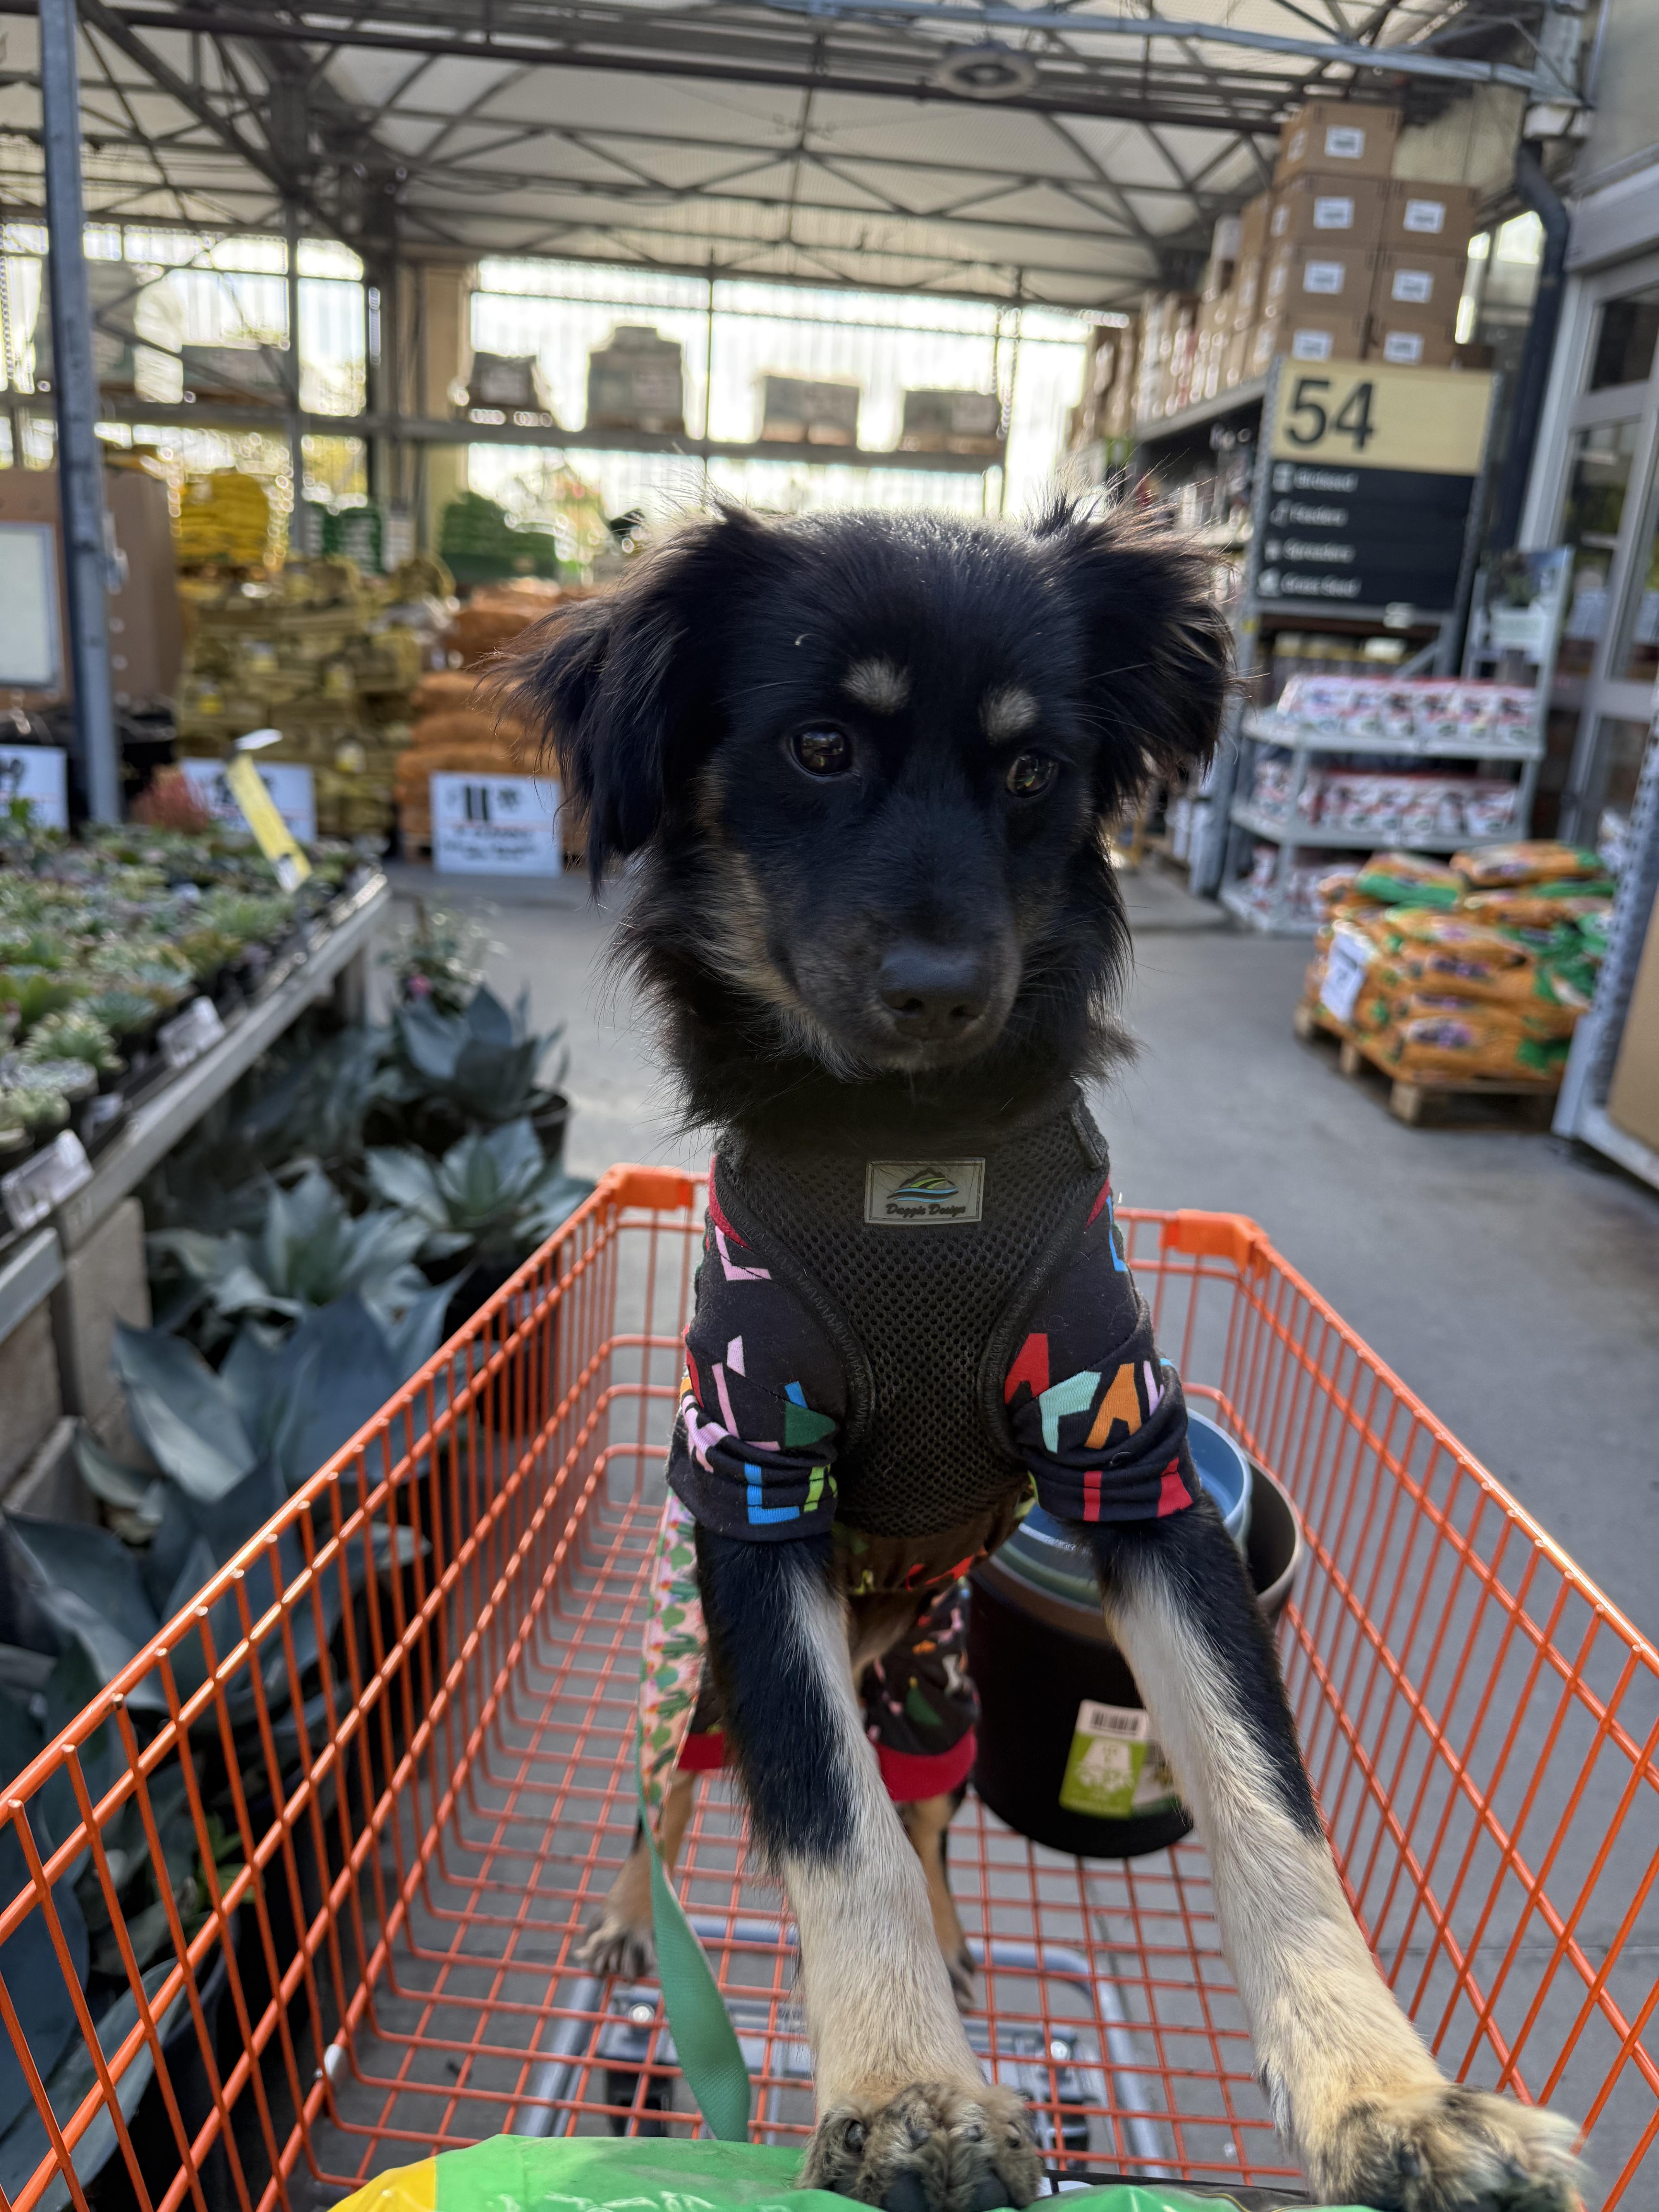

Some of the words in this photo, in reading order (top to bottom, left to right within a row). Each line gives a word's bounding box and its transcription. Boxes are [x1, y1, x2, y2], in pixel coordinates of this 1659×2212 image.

[1286, 376, 1376, 453] 54
[886, 1203, 926, 1218] Doggie
[928, 1203, 966, 1218] Design
